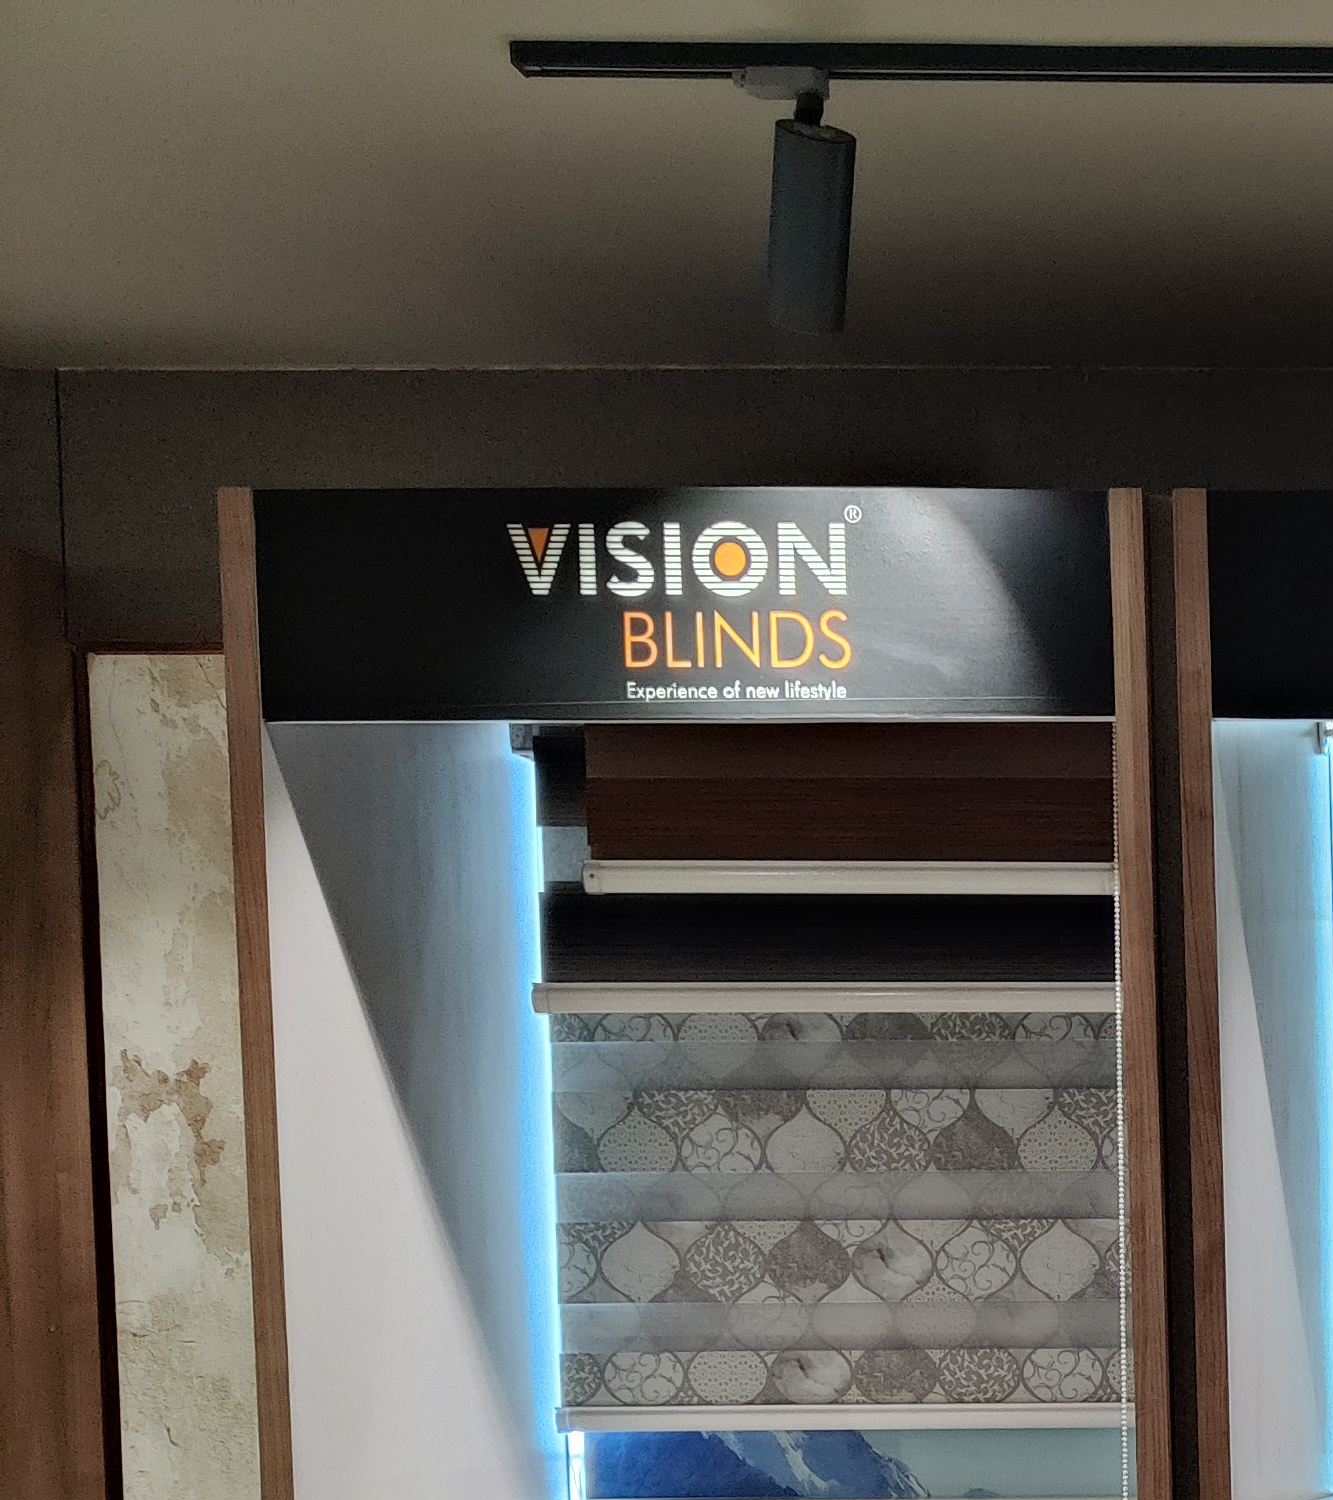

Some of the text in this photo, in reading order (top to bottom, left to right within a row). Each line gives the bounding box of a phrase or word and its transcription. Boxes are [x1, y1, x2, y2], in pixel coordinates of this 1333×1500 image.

[506, 520, 848, 597] VISION
[622, 609, 852, 669] BLINDS
[626, 680, 847, 702] Experience of new lifestyle
